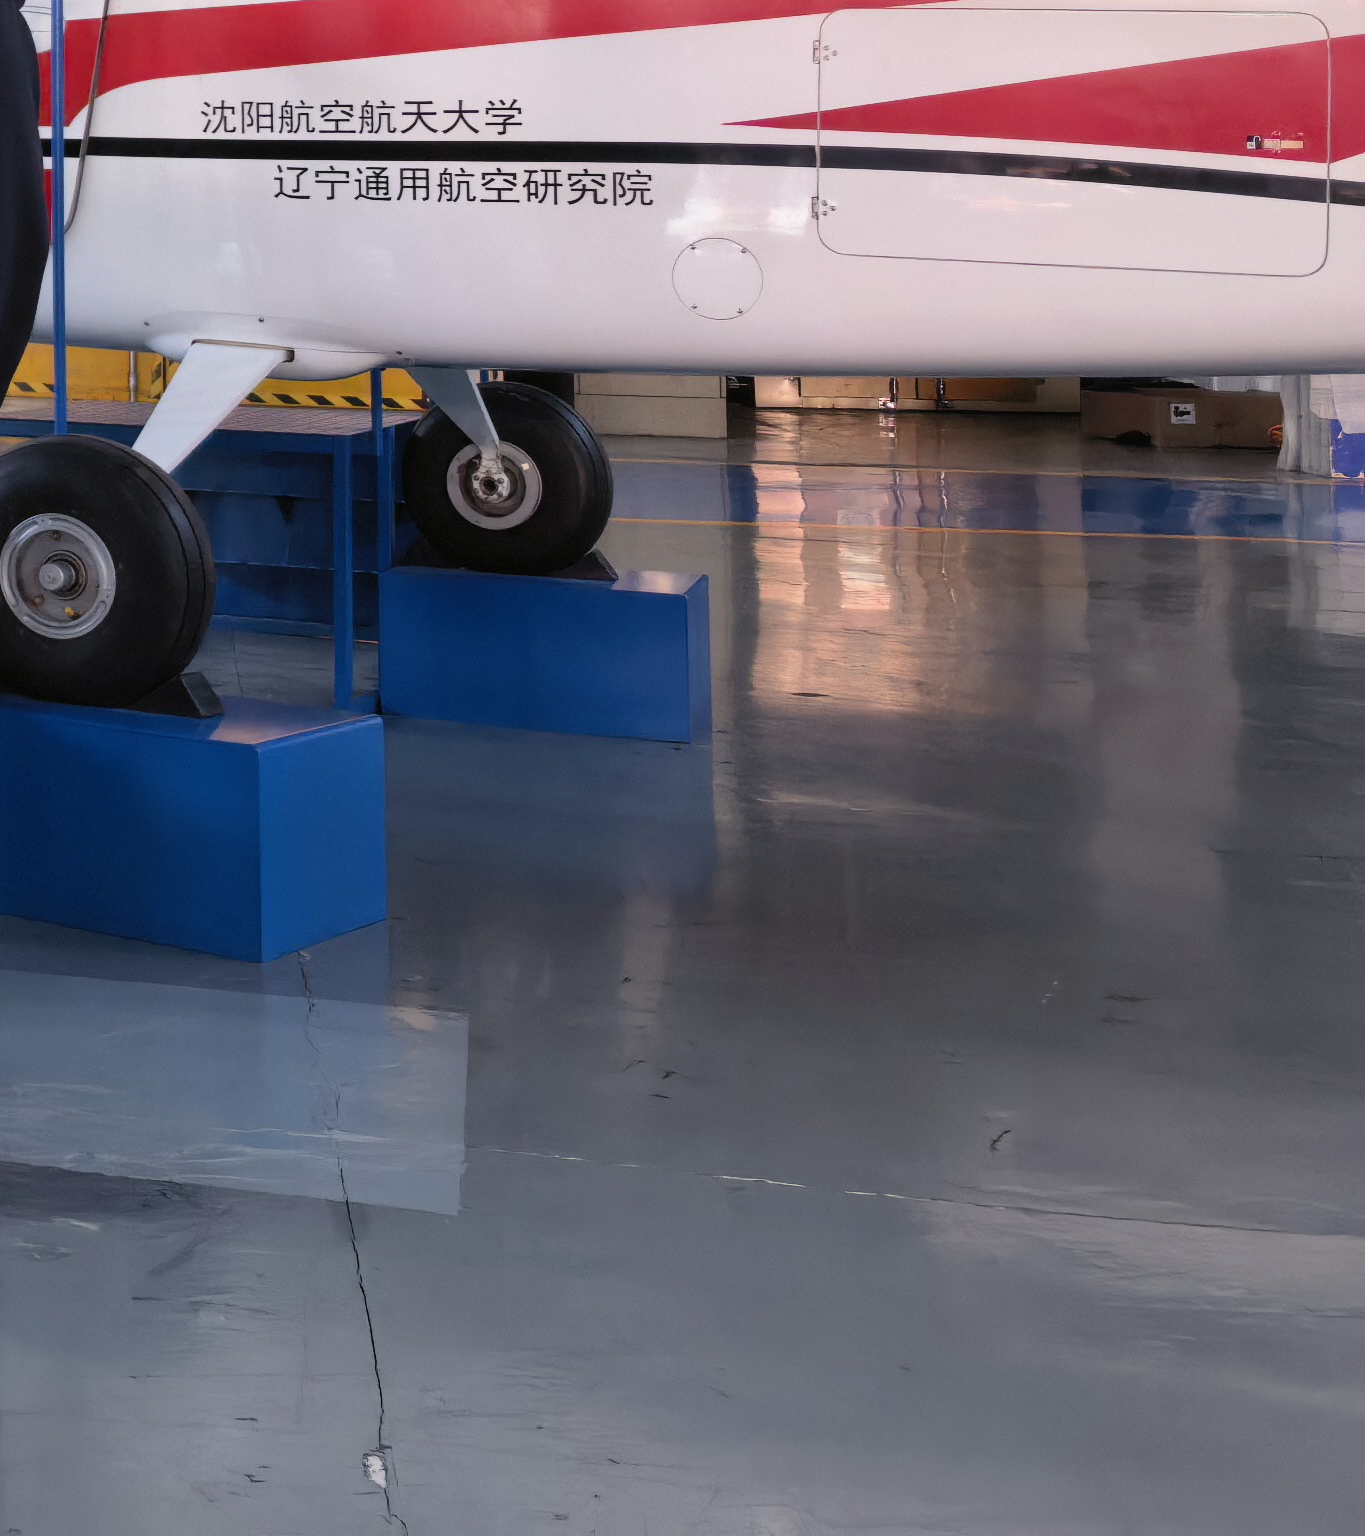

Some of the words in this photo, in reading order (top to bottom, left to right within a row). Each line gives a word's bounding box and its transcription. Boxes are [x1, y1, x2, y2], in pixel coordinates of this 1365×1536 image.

[201, 98, 524, 136] 沈阳航空航天大学
[273, 164, 655, 207] 辽宁通用航空研究院
